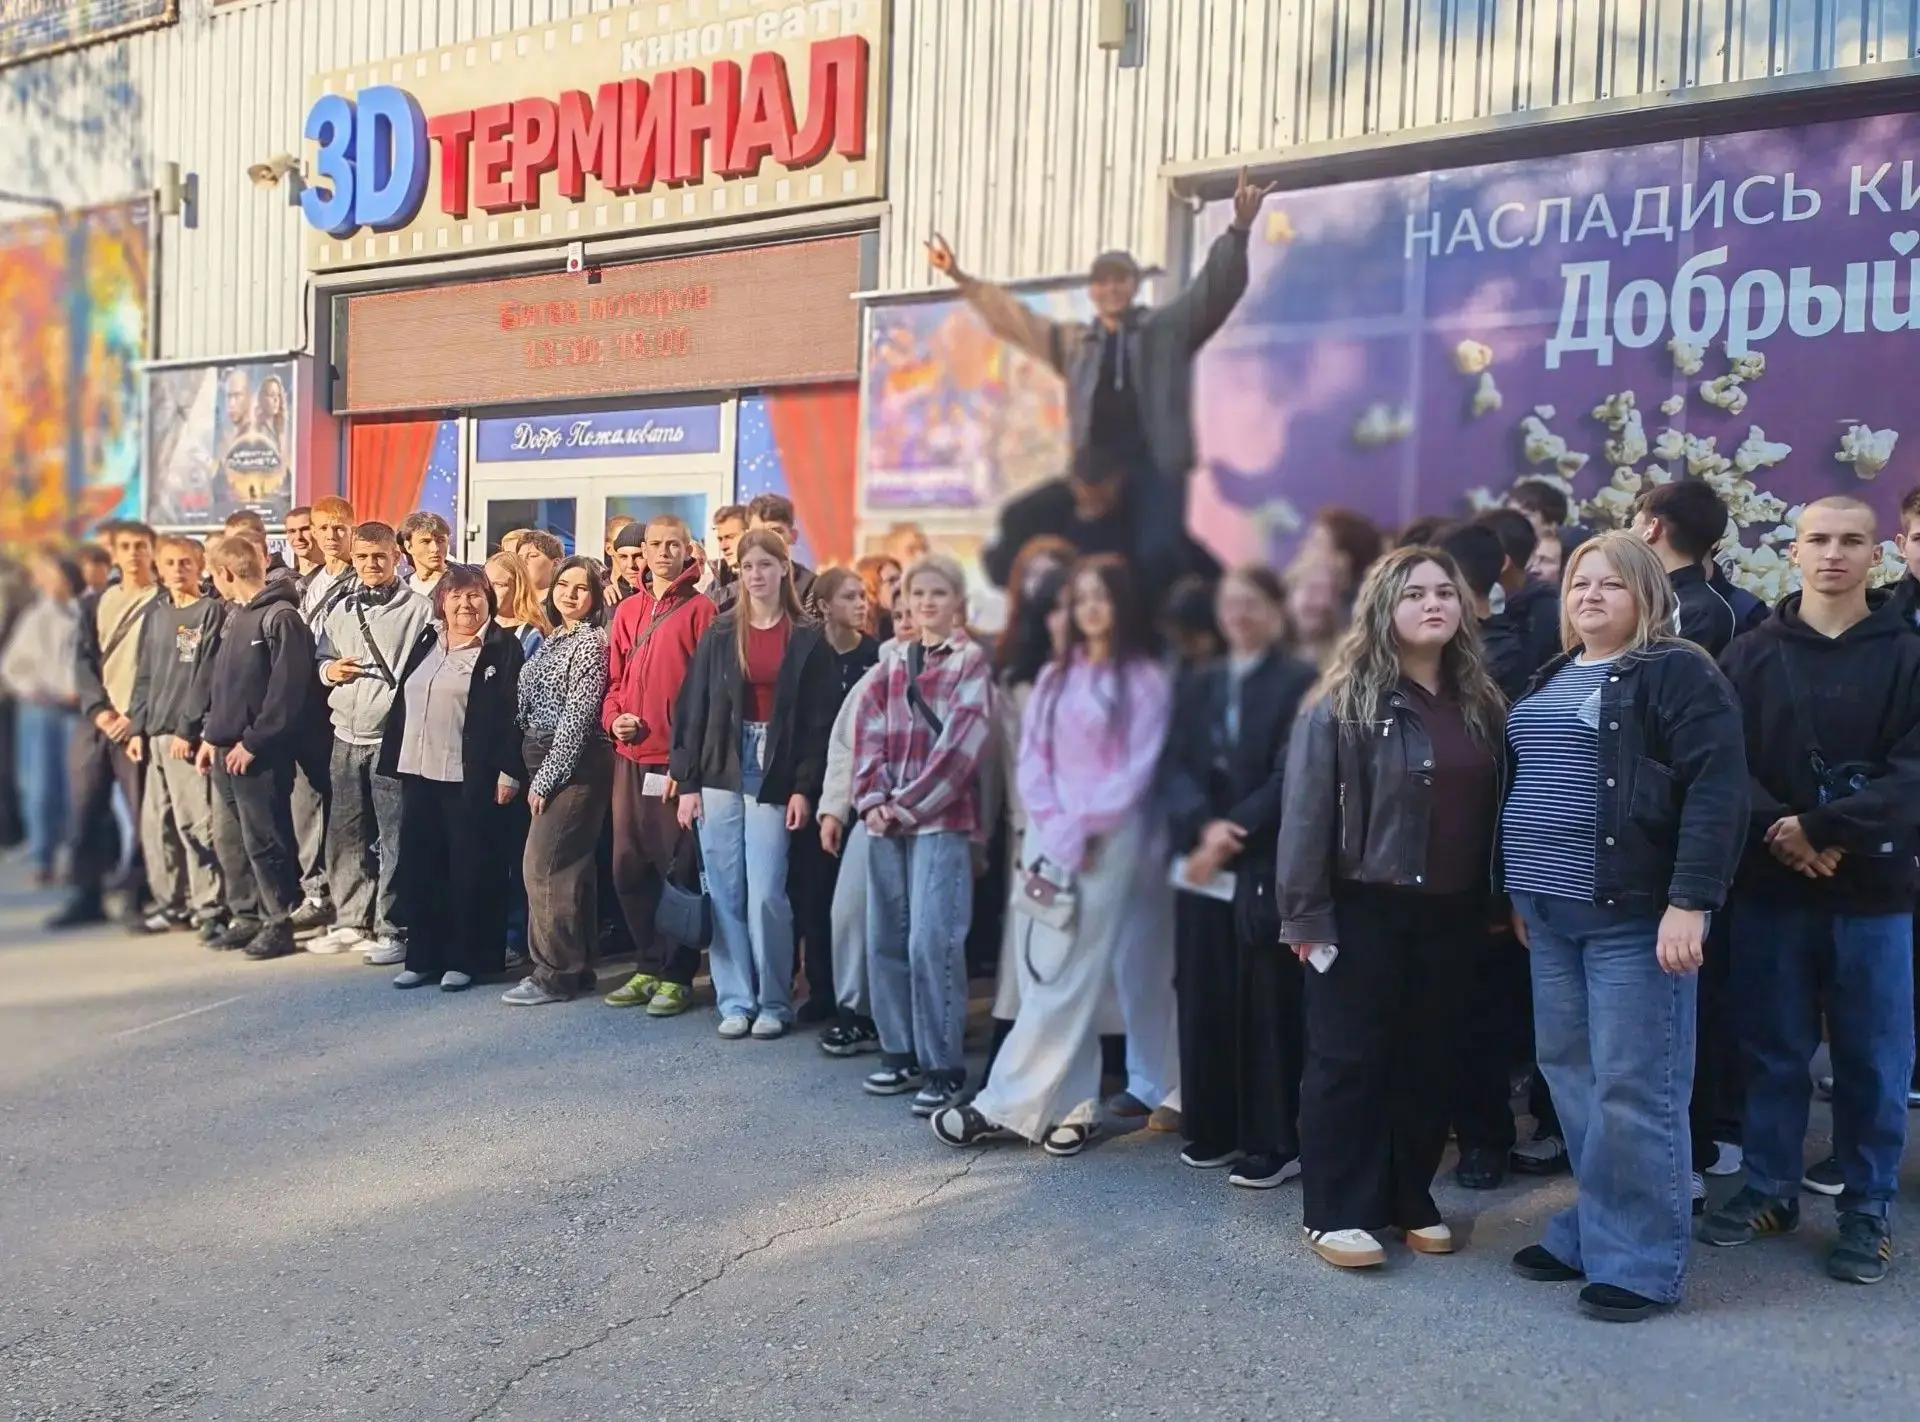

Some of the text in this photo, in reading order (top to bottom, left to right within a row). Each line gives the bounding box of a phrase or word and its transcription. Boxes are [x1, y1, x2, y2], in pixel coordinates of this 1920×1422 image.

[621, 0, 868, 72] кинотеатр
[301, 34, 869, 240] 3D ТЕРМИНАЛ
[1405, 172, 1822, 259] НАСЛАДИСЬ
[1545, 230, 1920, 370] Добрый
[511, 419, 685, 454] Добро Пожаловать
